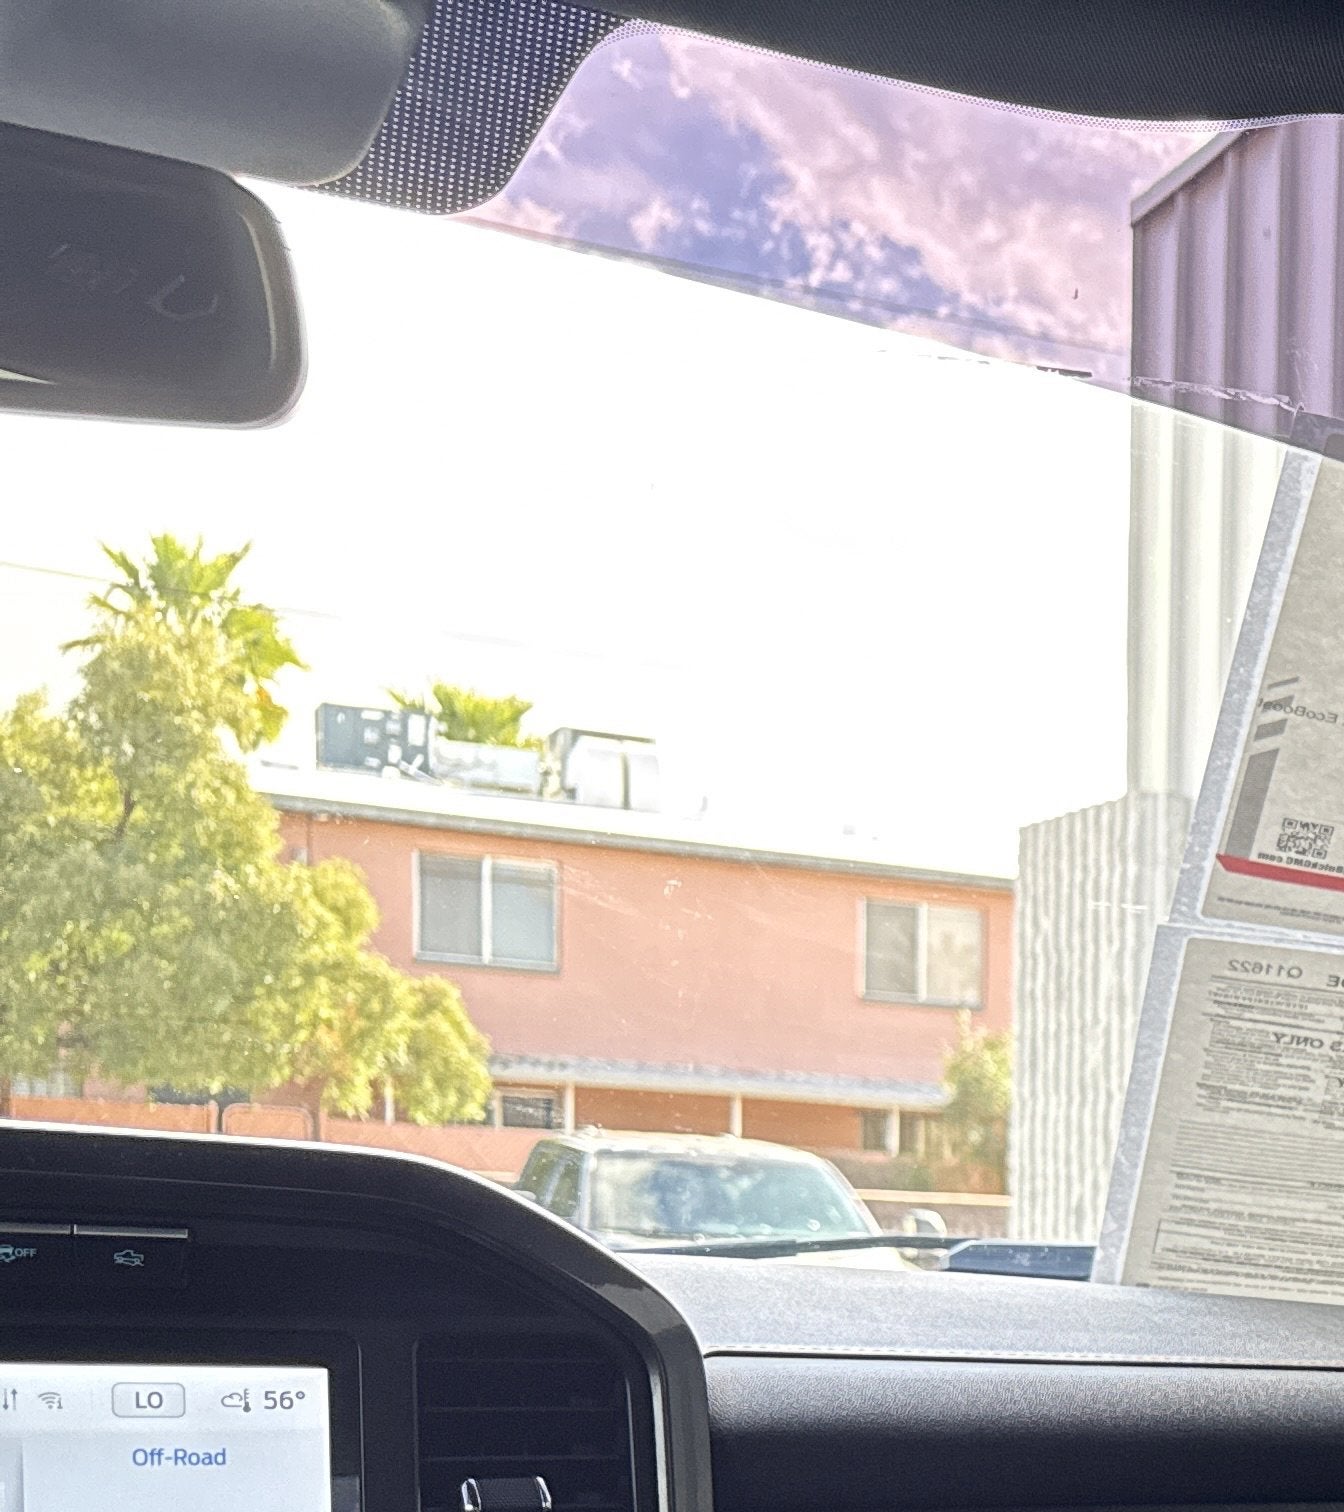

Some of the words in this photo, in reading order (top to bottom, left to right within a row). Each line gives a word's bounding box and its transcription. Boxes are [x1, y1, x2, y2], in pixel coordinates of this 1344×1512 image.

[14, 1247, 38, 1259] OFF
[135, 1391, 164, 1410] LO
[263, 1390, 306, 1410] 56°
[132, 1448, 228, 1466] Off-Road
